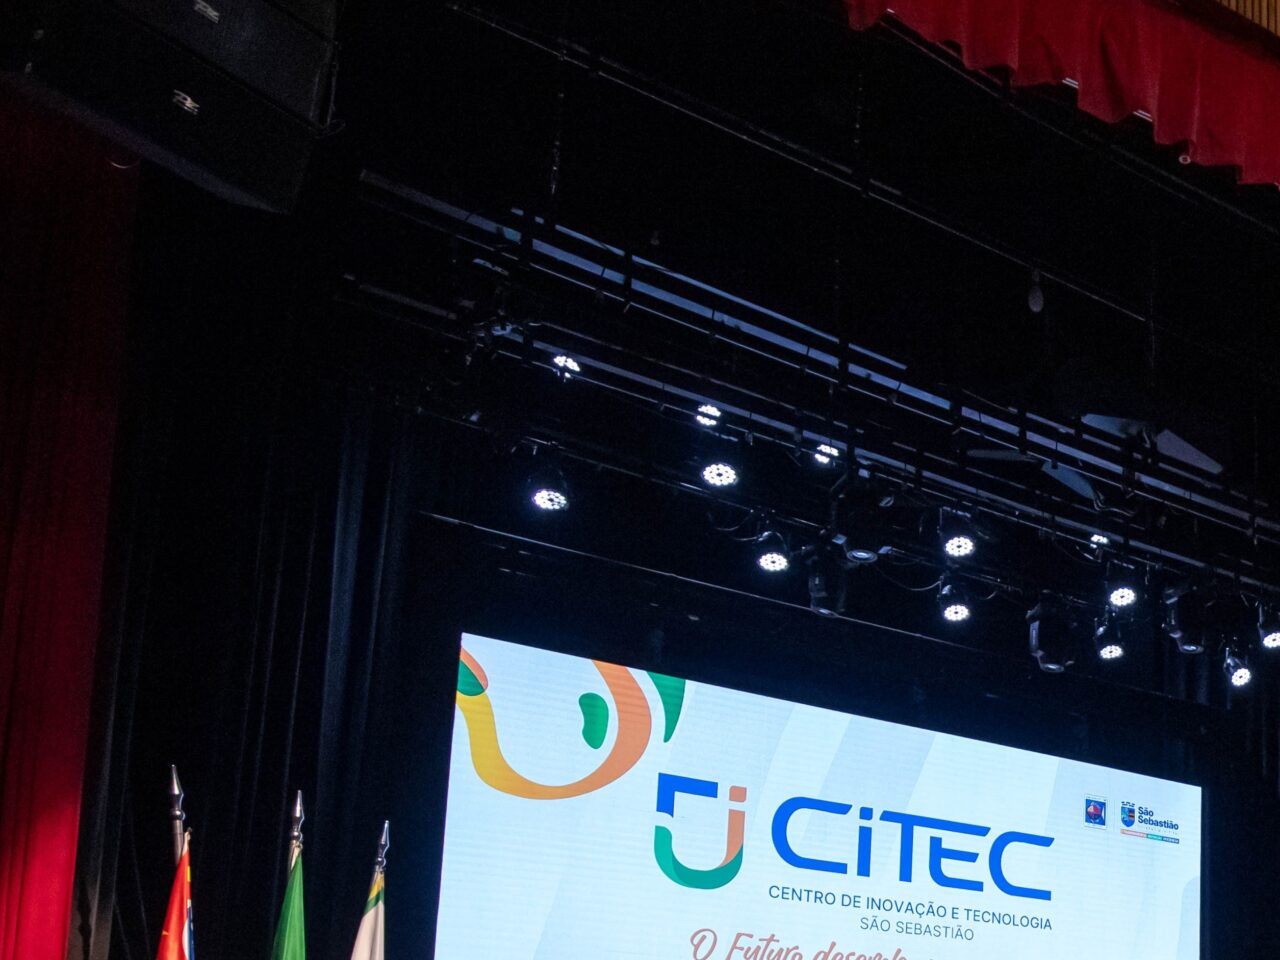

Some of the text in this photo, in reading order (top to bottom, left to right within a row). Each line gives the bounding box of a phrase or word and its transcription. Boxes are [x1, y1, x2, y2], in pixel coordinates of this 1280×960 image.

[1138, 806, 1154, 817] São
[1138, 815, 1179, 830] Sebastião
[768, 885, 1053, 931] CENTRO DE INOVAÇÃO E TECNOLOGIA
[860, 915, 974, 941] SÃO SEBASTIÃO
